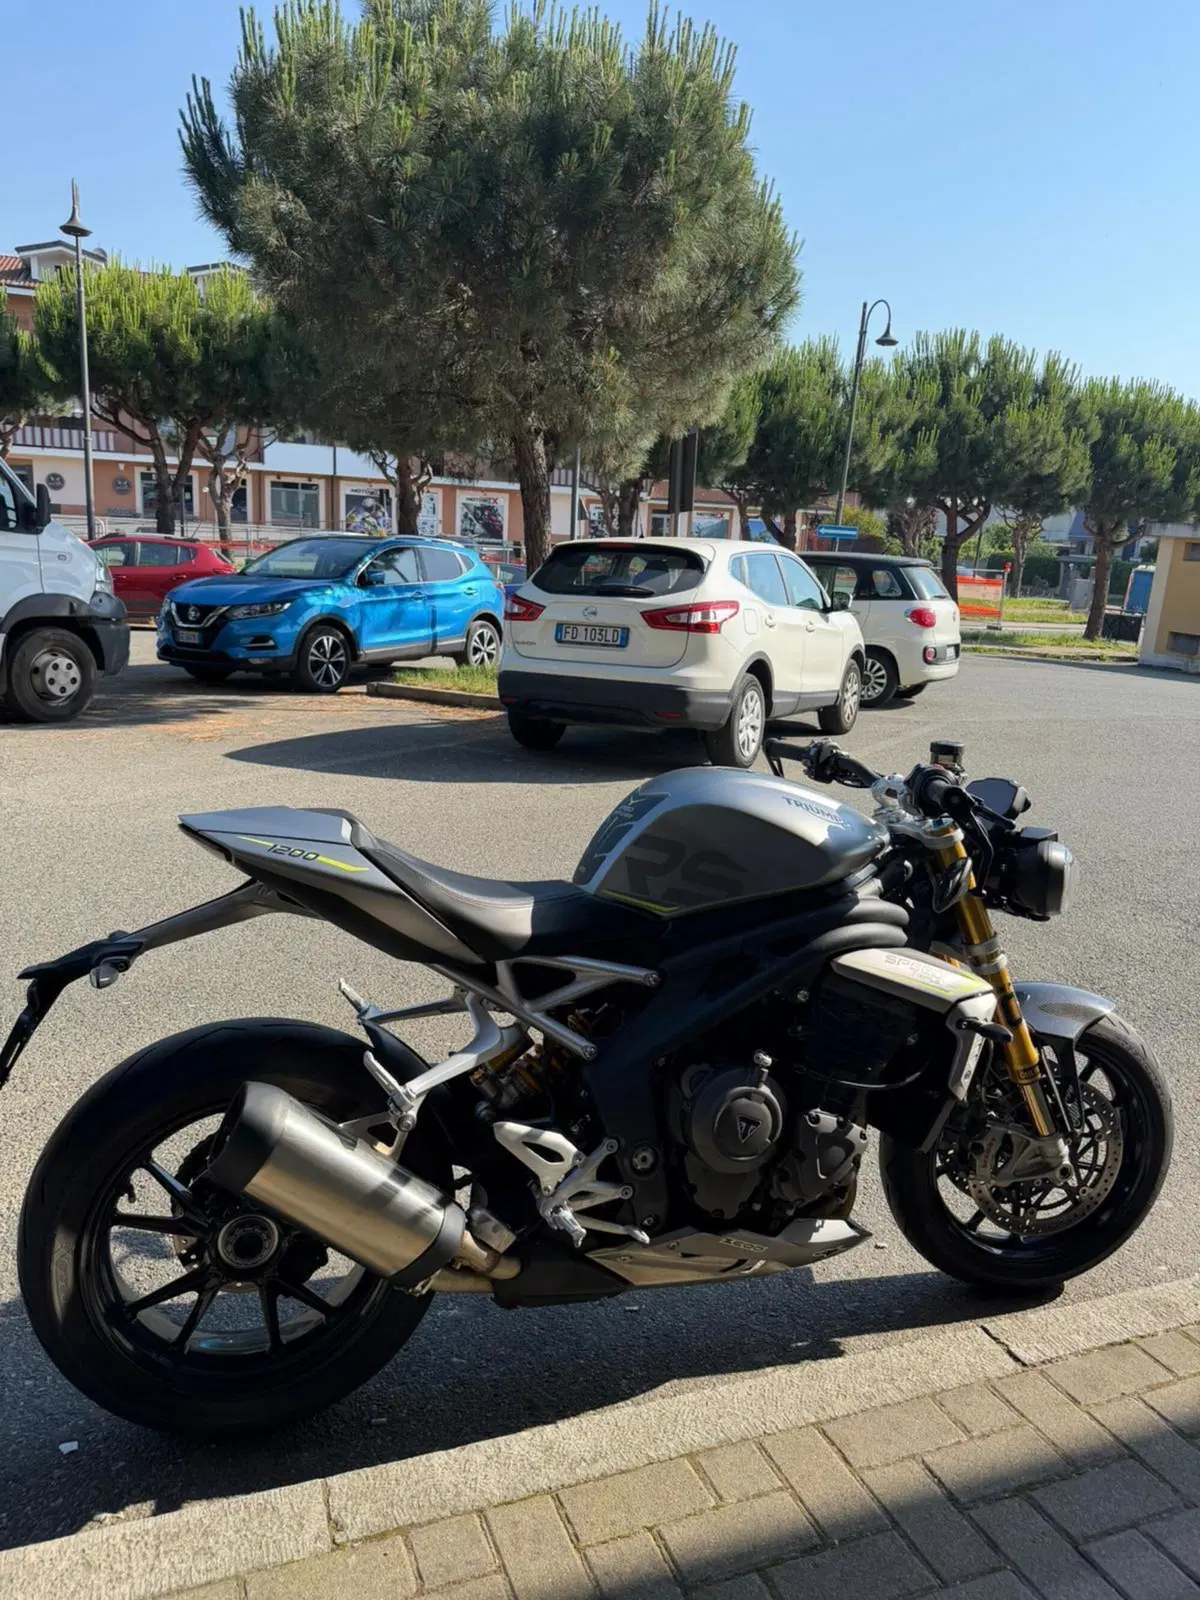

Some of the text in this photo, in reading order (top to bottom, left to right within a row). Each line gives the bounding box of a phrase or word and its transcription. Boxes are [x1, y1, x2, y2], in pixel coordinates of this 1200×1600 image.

[563, 626, 620, 643] FD 103LD
[267, 843, 320, 861] 1200
[884, 954, 944, 980] SPEED
